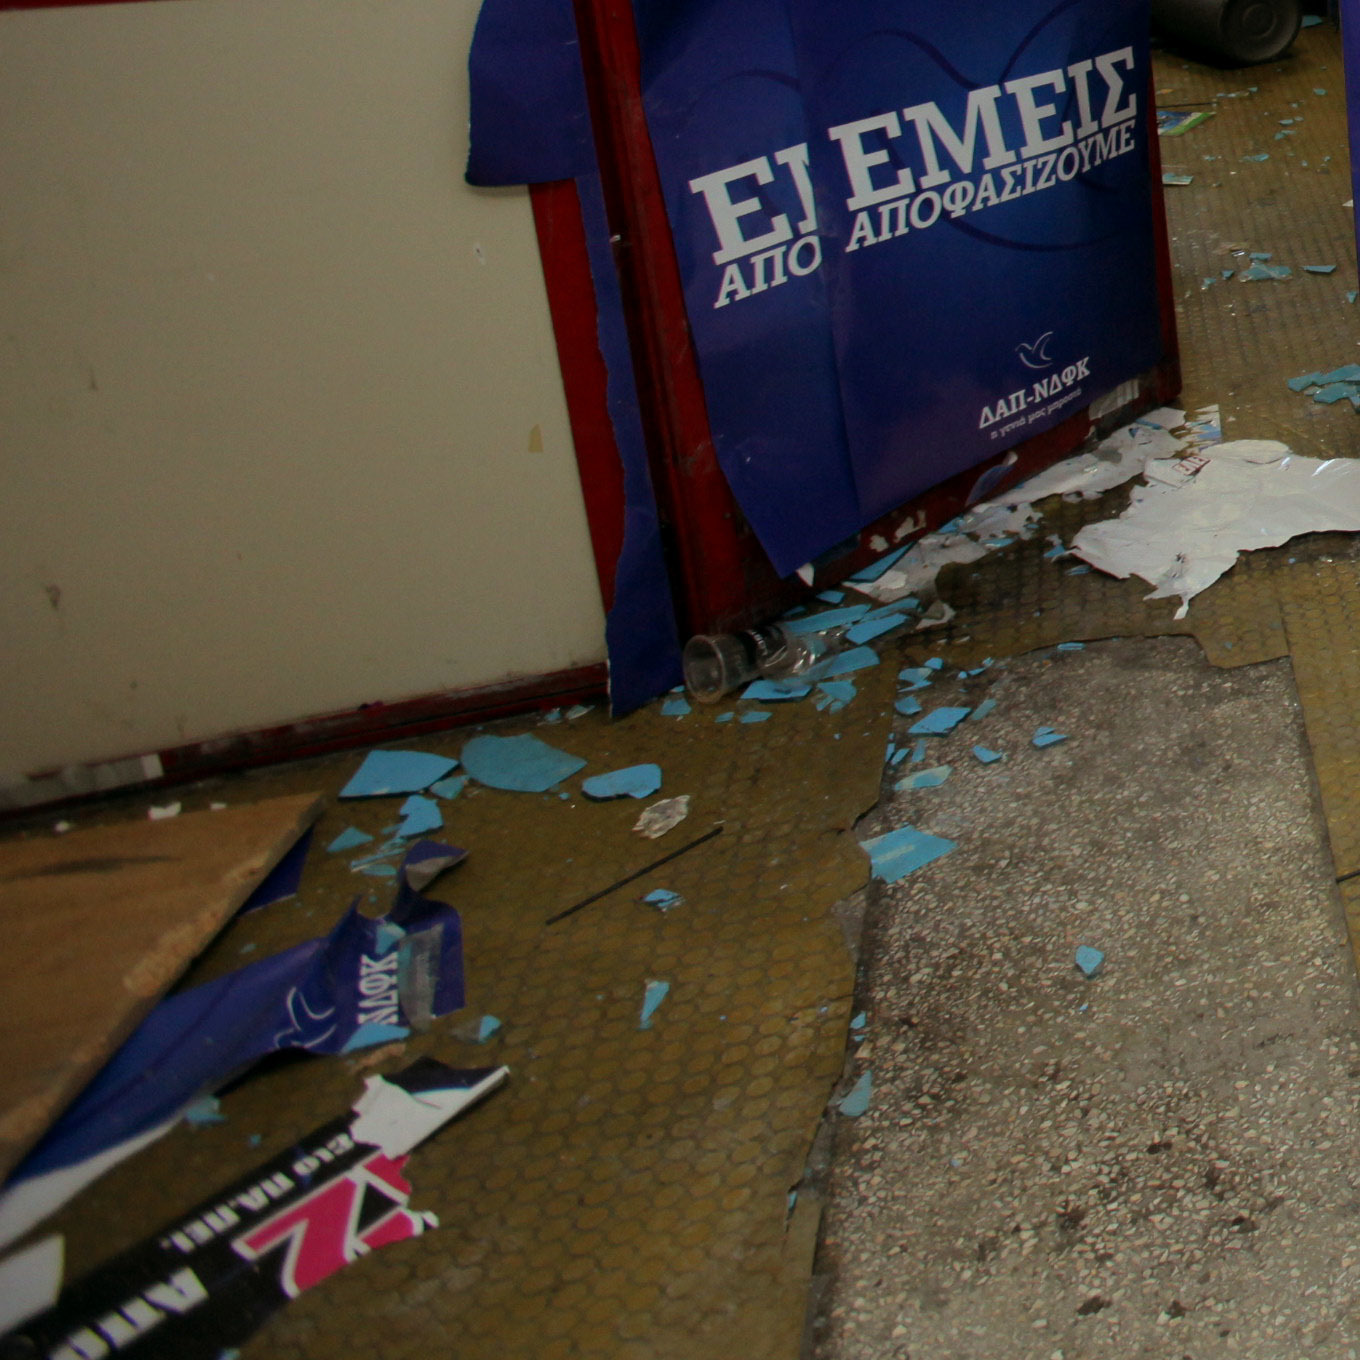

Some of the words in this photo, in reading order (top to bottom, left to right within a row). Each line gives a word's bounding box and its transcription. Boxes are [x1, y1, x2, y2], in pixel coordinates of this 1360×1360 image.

[828, 46, 1137, 213] ΕΜΕΙΣ
[845, 119, 1136, 253] ΑΠΟΦΑΣΙΖΟΥΜΕ
[713, 236, 822, 309] ΑΠΟ
[978, 357, 1091, 429] ΔΑΠ-ΝΔΦΚ
